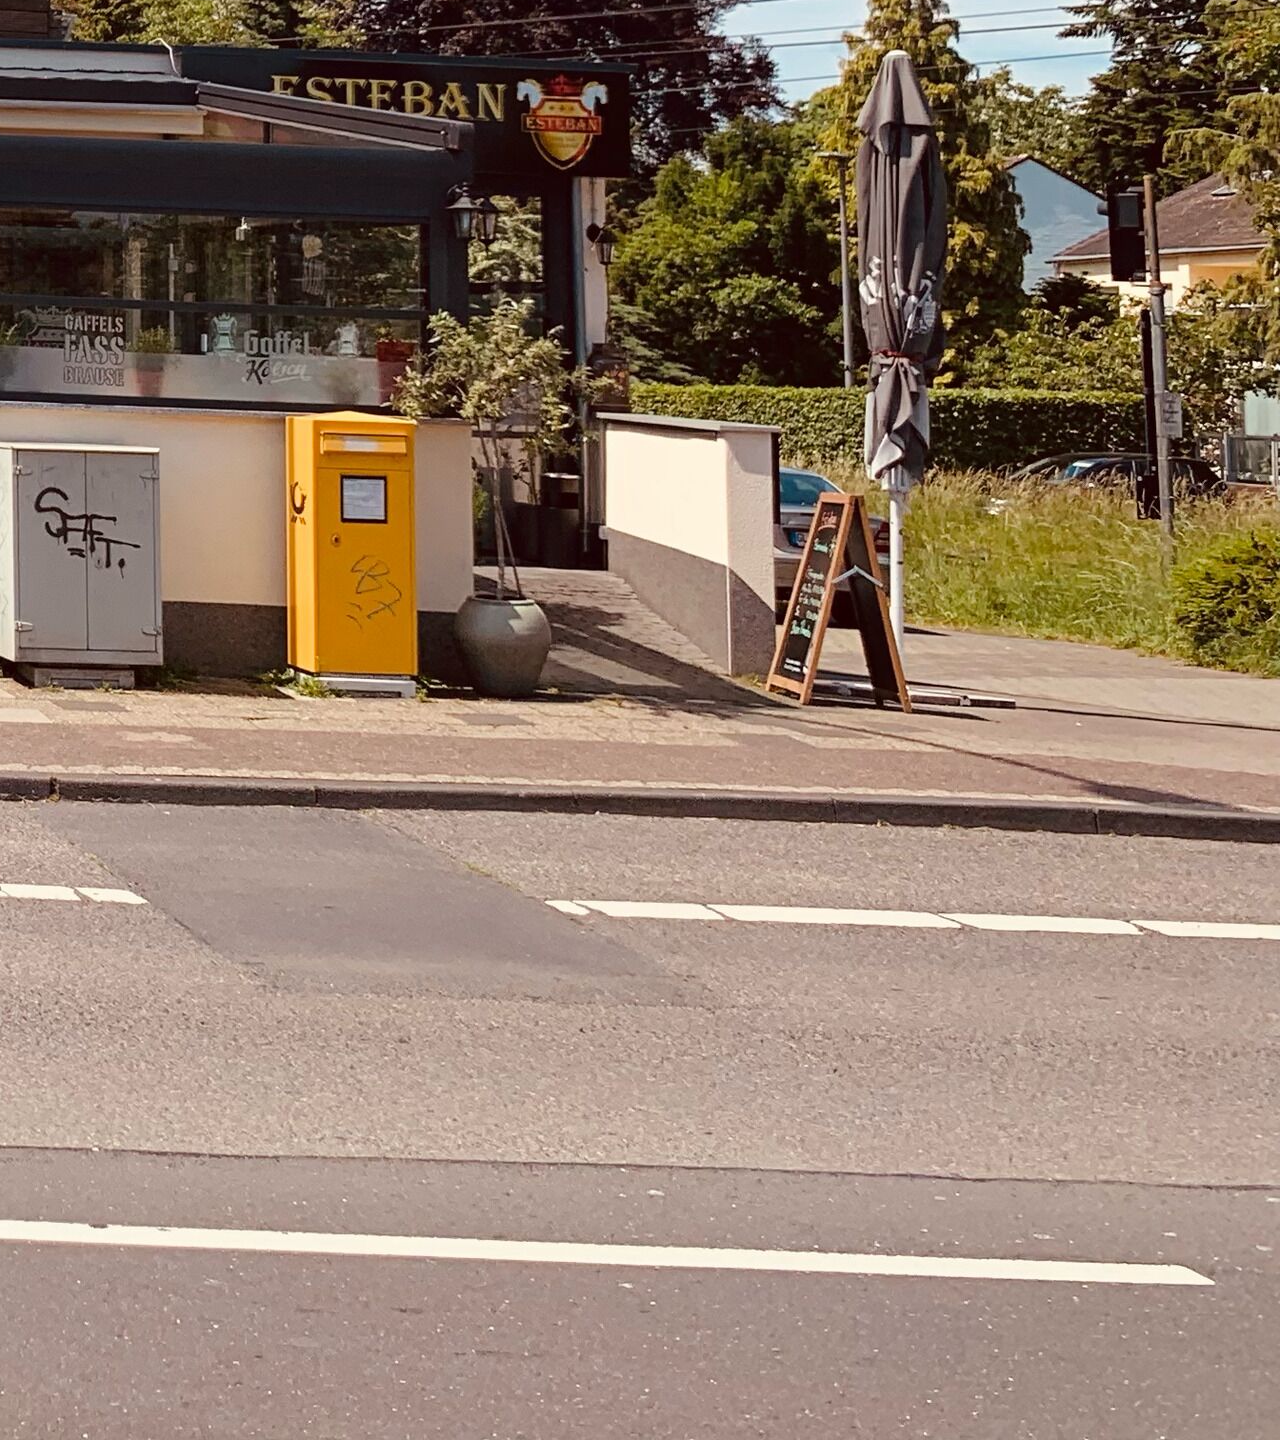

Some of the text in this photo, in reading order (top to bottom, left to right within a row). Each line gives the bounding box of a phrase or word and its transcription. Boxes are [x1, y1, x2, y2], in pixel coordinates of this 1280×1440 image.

[271, 75, 508, 122] ESTEBAN
[526, 116, 598, 131] ESTEBAN
[64, 314, 124, 333] GAFFELS
[64, 335, 124, 365] FASS
[64, 366, 125, 387] BRAUSE
